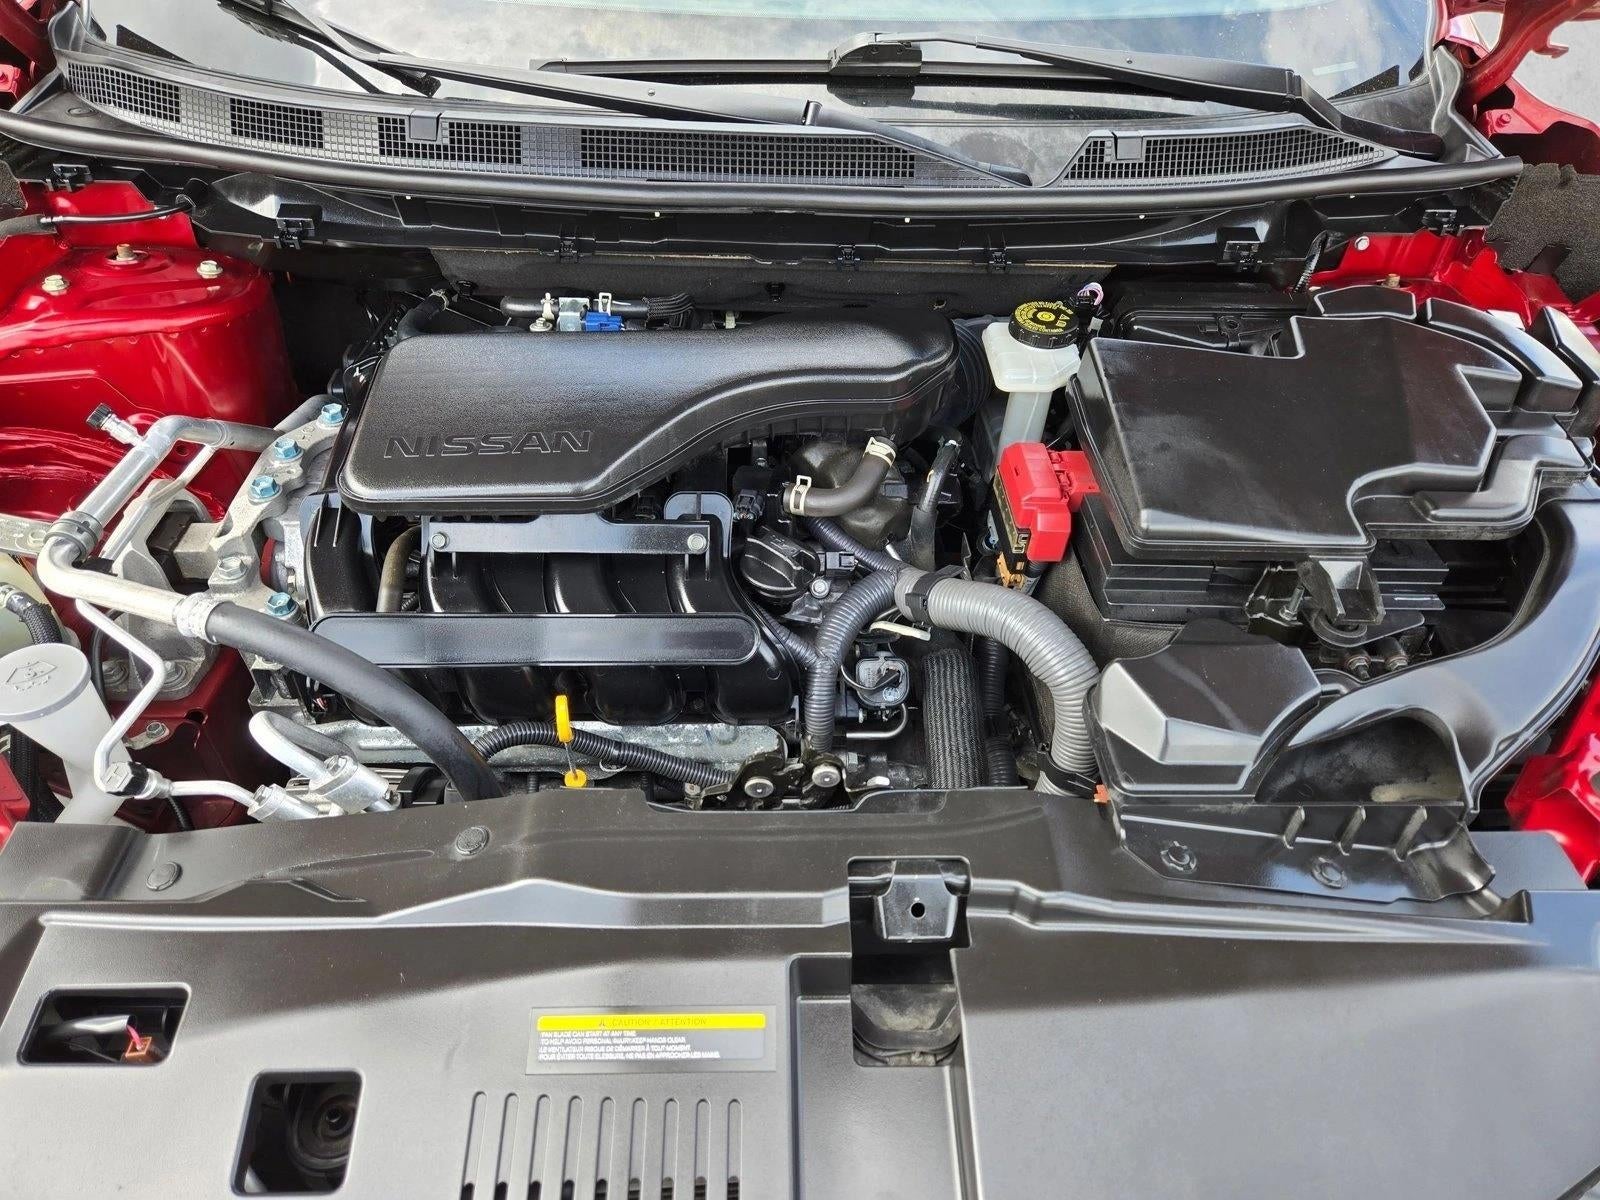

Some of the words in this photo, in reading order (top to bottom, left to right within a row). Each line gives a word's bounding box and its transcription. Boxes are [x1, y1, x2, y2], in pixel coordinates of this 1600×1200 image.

[383, 430, 592, 459] NISSAN
[612, 1018, 650, 1026] CAUTION
[660, 1018, 707, 1026] ATTENTION
